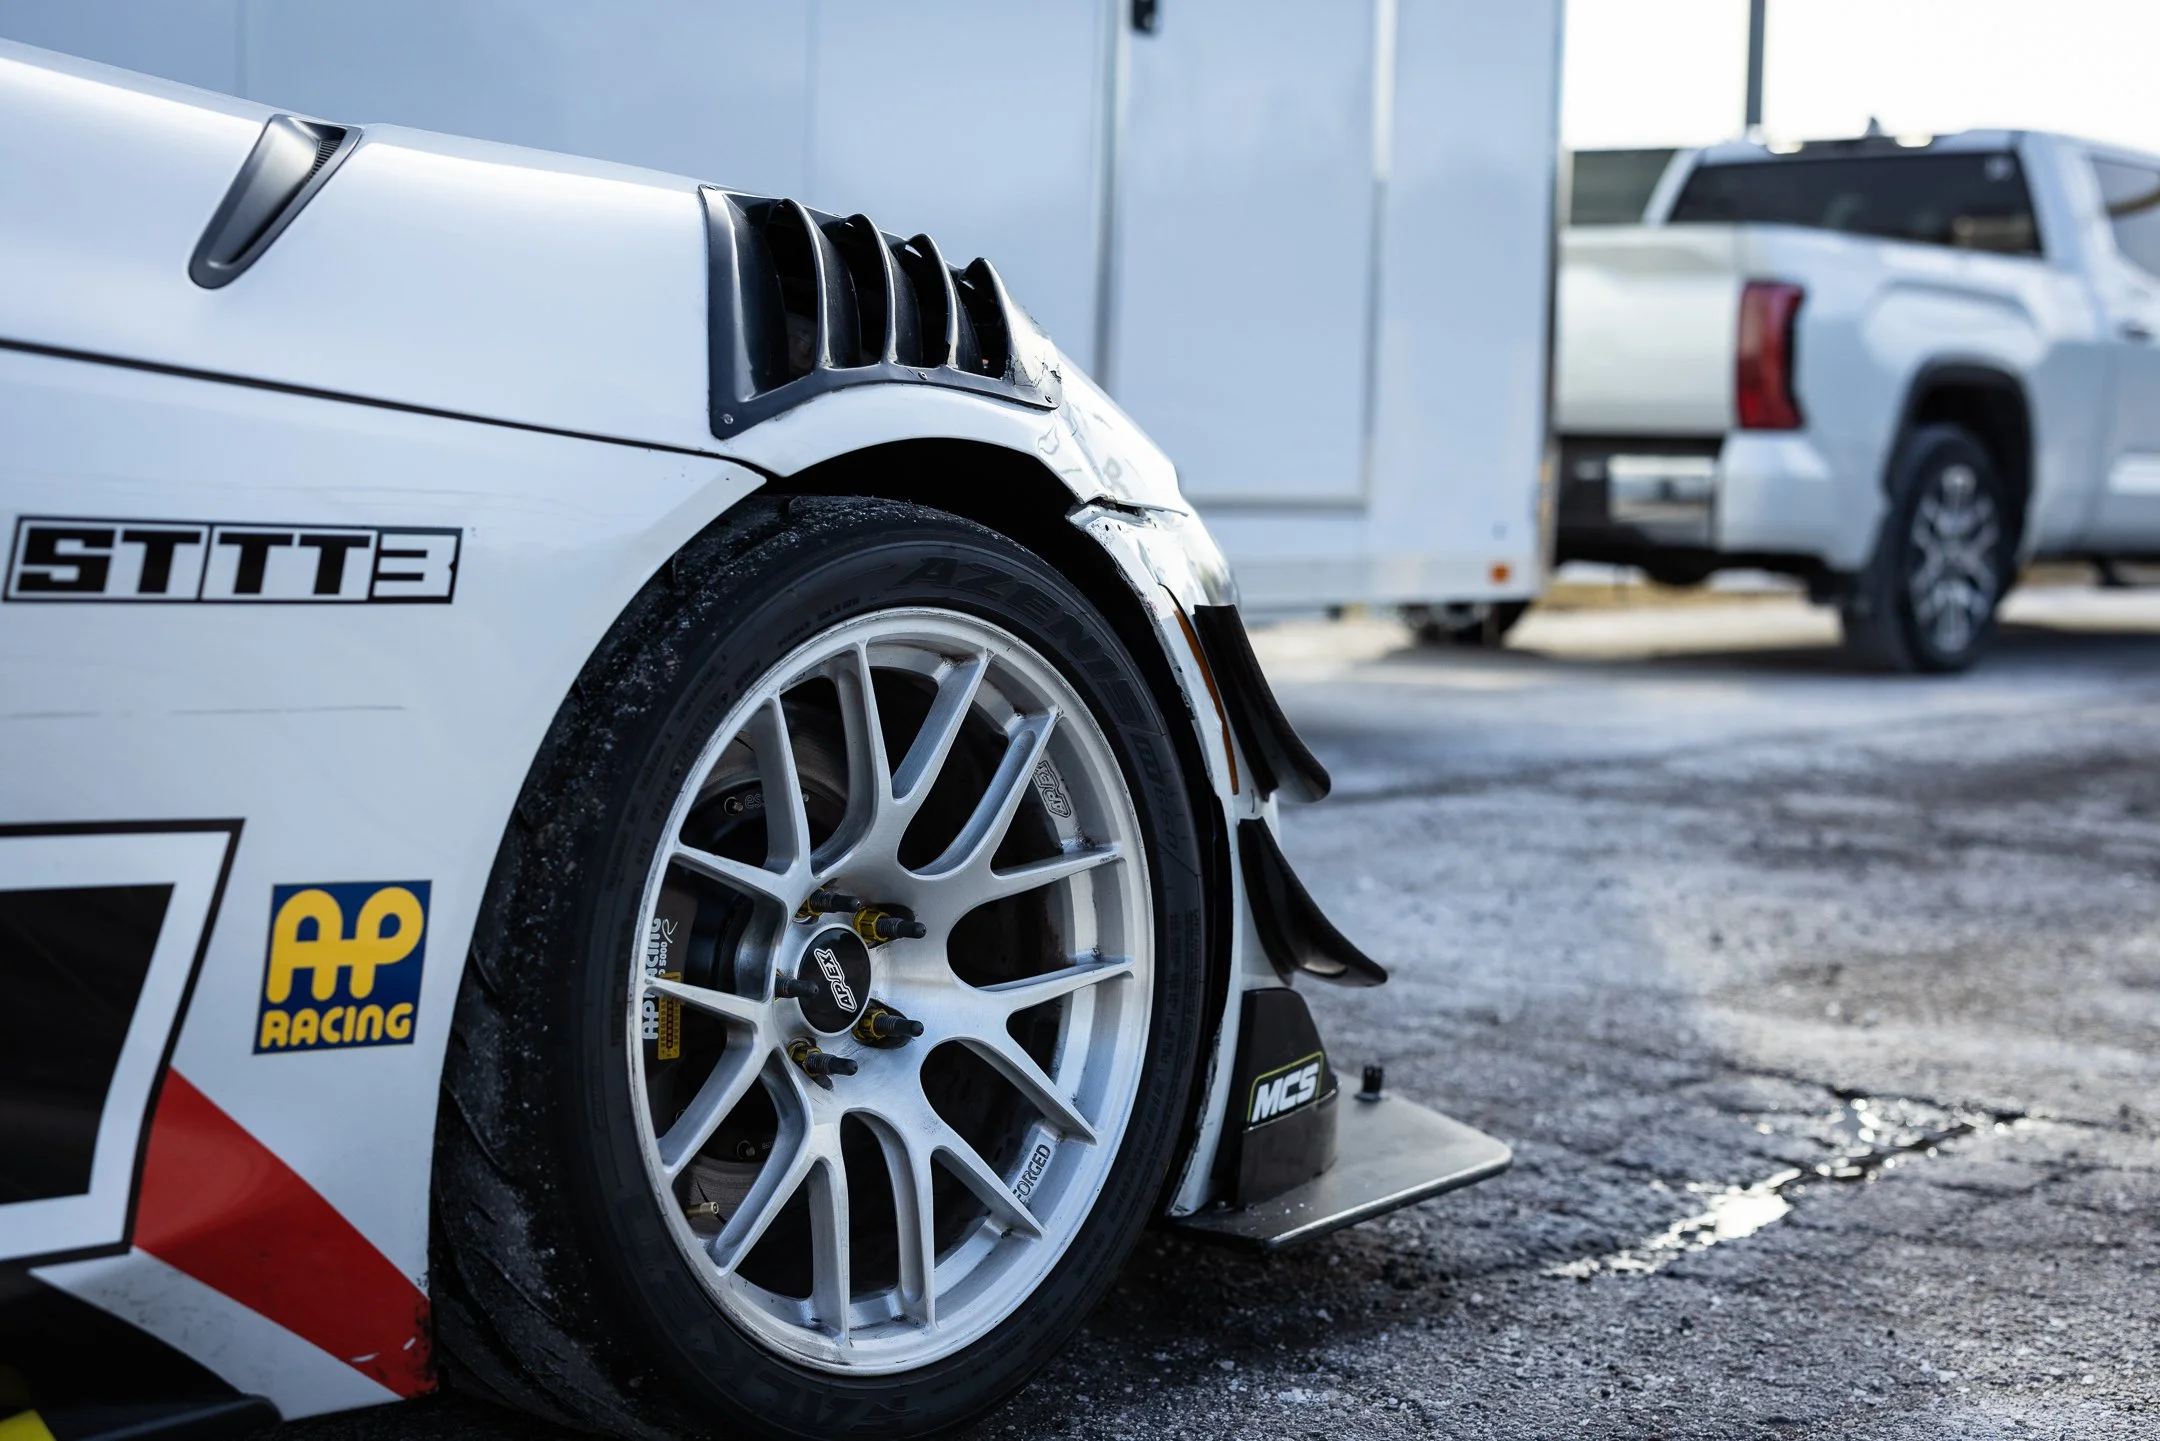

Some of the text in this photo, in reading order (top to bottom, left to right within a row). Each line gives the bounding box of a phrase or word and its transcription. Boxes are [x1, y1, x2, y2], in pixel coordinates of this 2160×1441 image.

[889, 555, 1148, 725] AZENIS
[265, 886, 424, 1003] AP
[658, 941, 668, 967] 5000
[642, 917, 662, 1040] AP ACING
[814, 948, 857, 1013] APEX
[259, 1002, 413, 1050] RACING
[1251, 1062, 1320, 1123] MCS
[1012, 1143, 1051, 1204] FORGED
